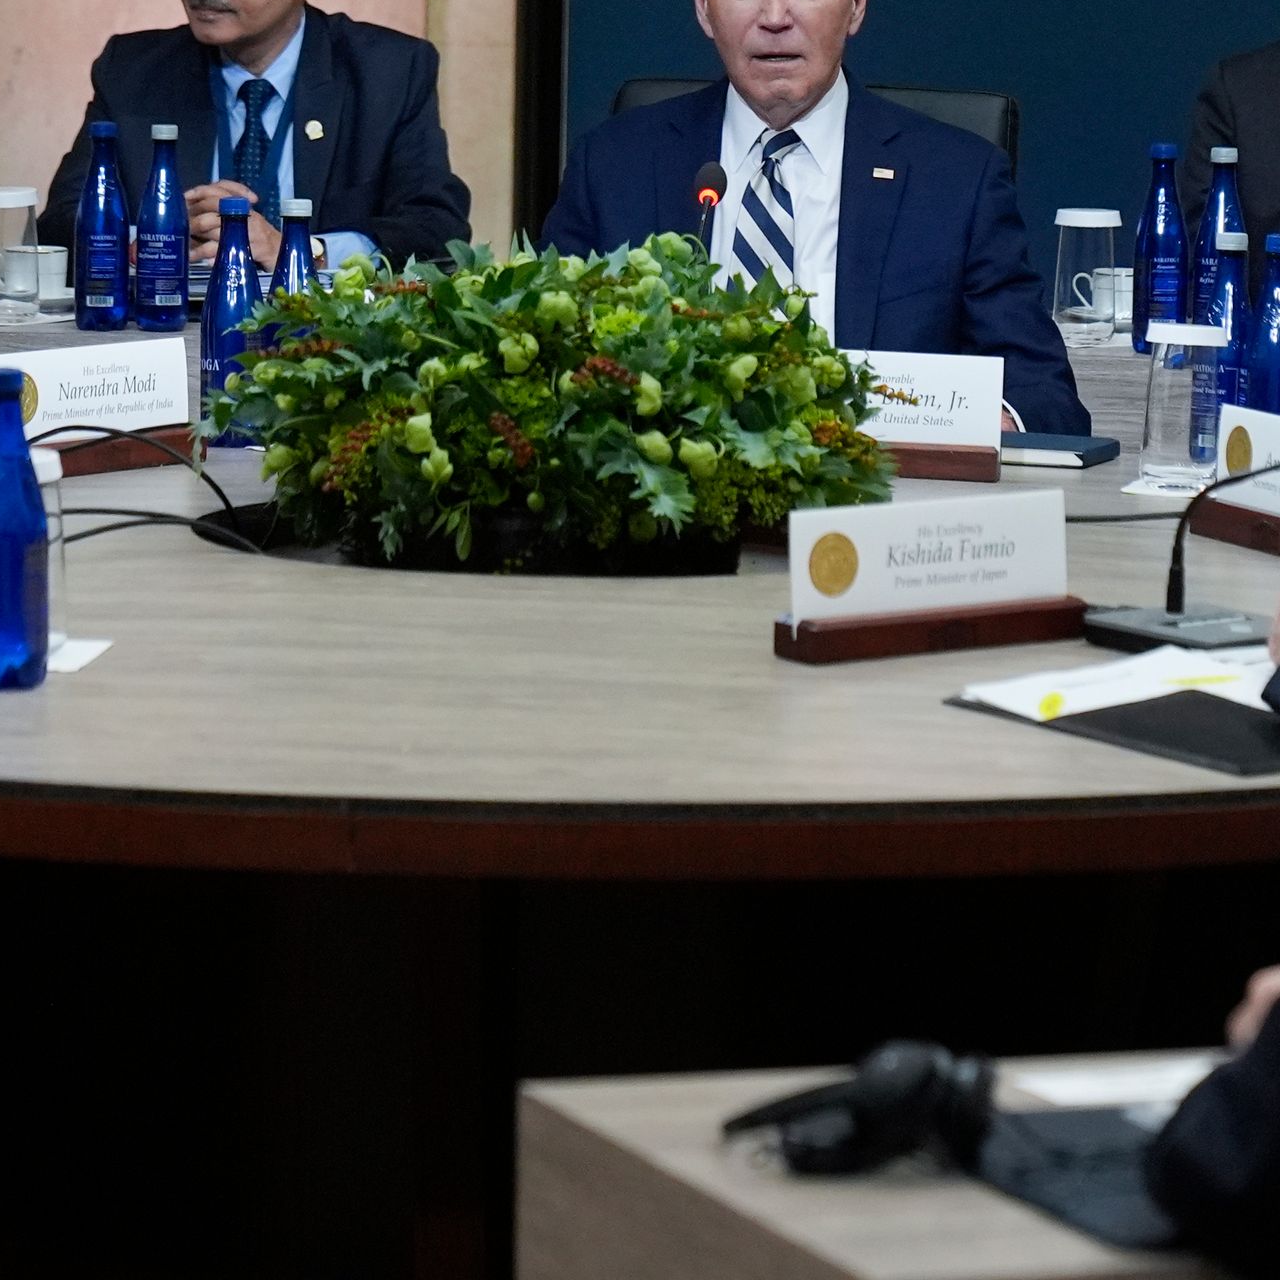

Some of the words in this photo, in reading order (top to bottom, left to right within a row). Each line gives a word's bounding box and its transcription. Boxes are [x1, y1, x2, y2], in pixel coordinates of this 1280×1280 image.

[59, 378, 119, 401] Narendra
[123, 373, 157, 395] Modi
[877, 373, 915, 385] norable
[42, 410, 63, 421] Prime
[65, 406, 94, 419] Minister
[95, 405, 104, 418] of
[104, 404, 116, 415] the
[117, 401, 146, 415] Republic
[147, 400, 155, 413] of
[155, 398, 174, 409] India
[947, 390, 970, 413] Jr.
[883, 412, 921, 426] United
[922, 414, 954, 427] States
[886, 542, 953, 569] Kishida
[959, 536, 1016, 561] Fumio
[894, 575, 922, 589] Prime
[926, 571, 968, 587] Minister
[970, 569, 980, 583] of
[980, 568, 1008, 584] Japan
